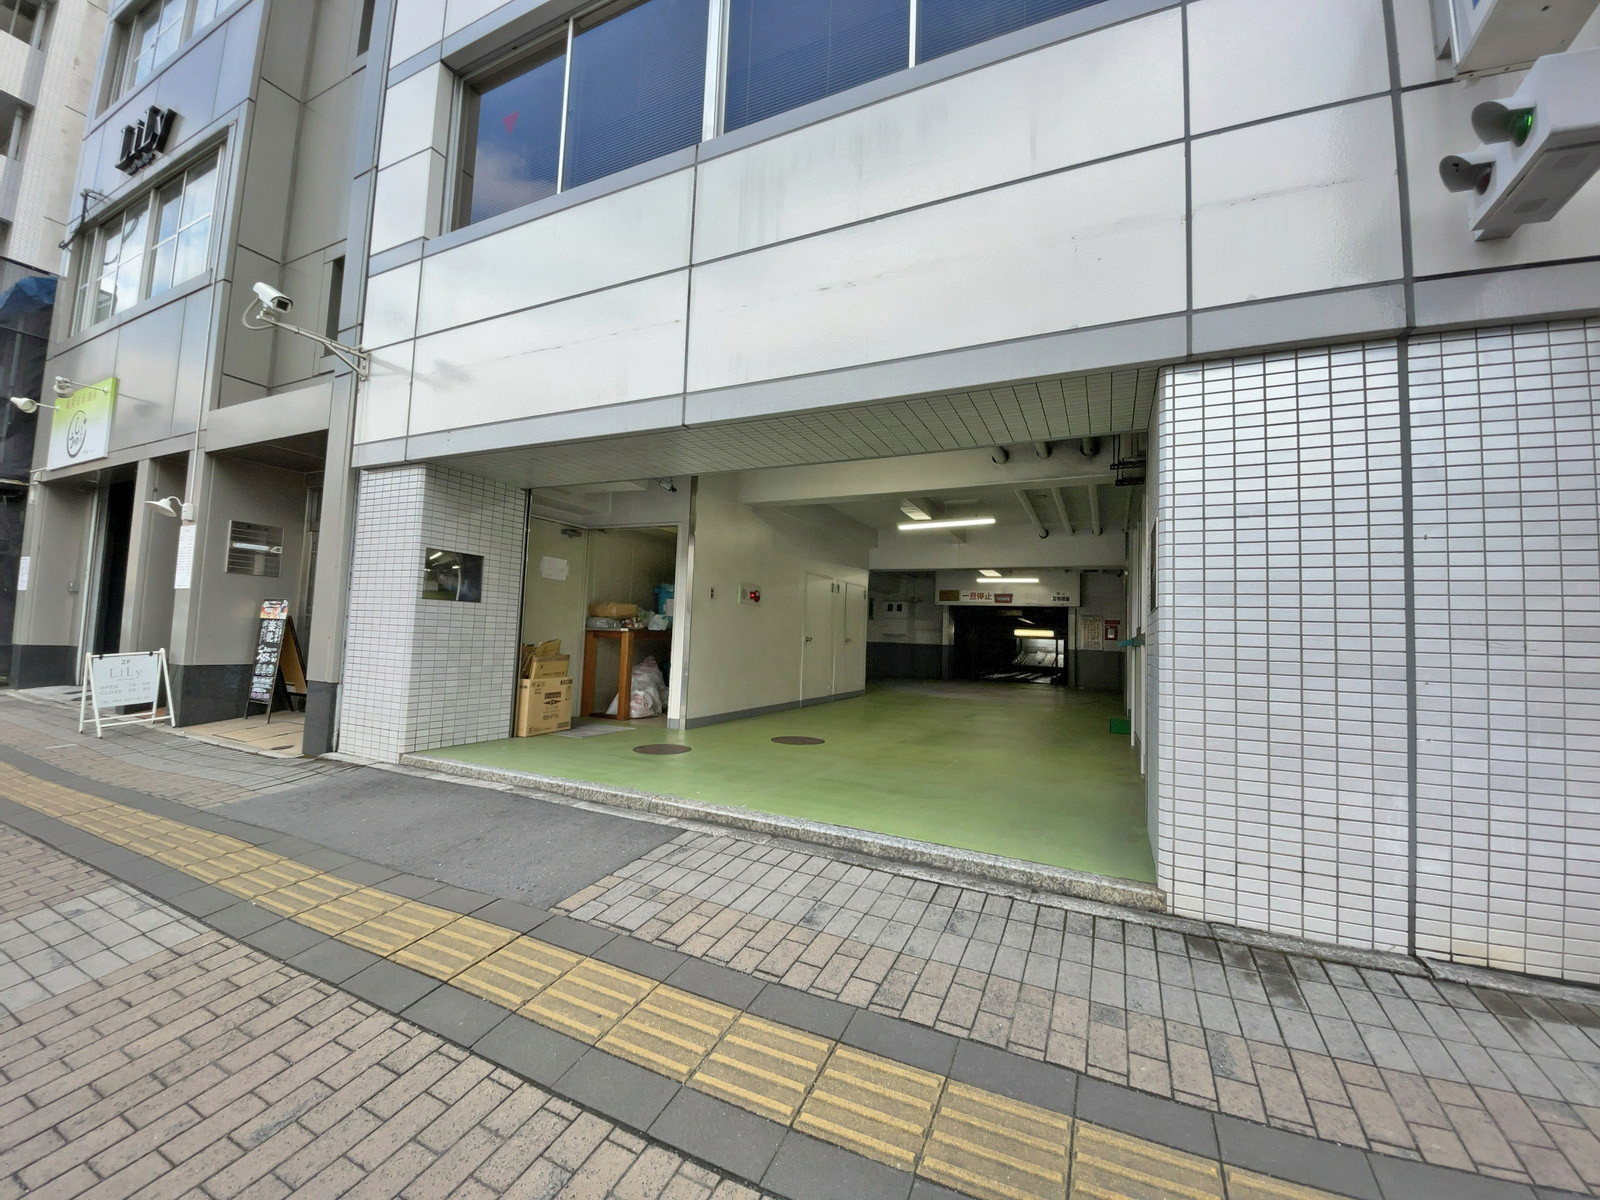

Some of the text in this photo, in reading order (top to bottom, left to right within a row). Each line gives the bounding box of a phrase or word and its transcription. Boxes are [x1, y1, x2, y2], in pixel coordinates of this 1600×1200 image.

[962, 592, 993, 600] 一旦停止
[109, 667, 143, 679] LiLy
